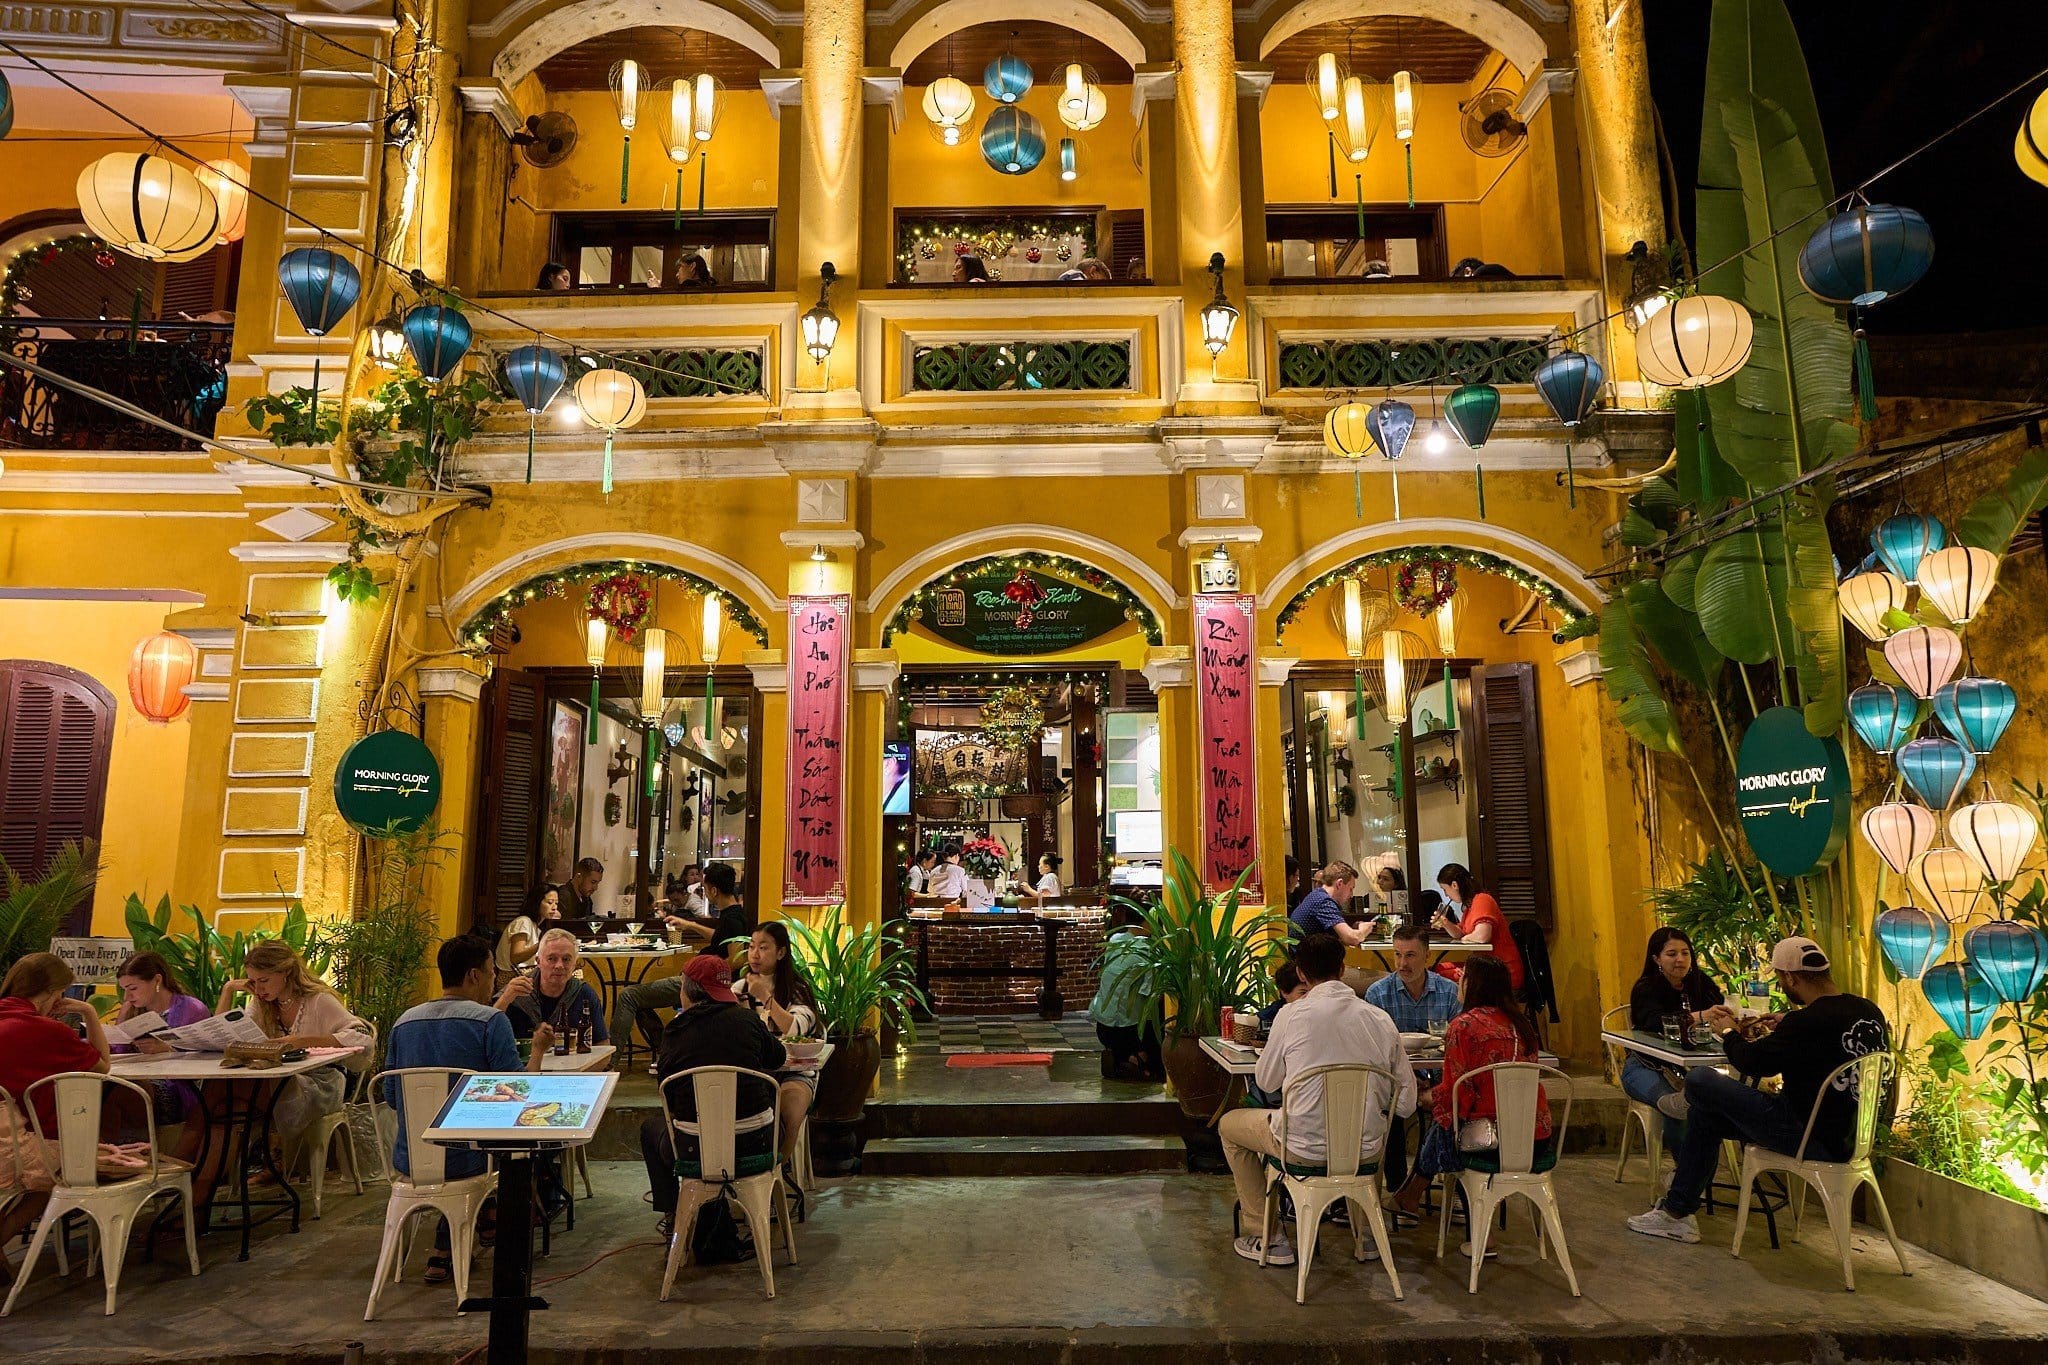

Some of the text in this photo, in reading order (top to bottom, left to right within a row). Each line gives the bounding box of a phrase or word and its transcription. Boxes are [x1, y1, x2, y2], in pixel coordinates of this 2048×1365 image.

[1205, 570, 1237, 586] 106
[984, 609, 1070, 622] MORNI GLORY
[354, 769, 430, 784] MORNING GLORY
[1740, 766, 1827, 791] MORNING GLORY
[56, 946, 75, 960] Open
[77, 946, 96, 959] Time
[97, 946, 119, 962] Every
[77, 965, 99, 976] 11AM
